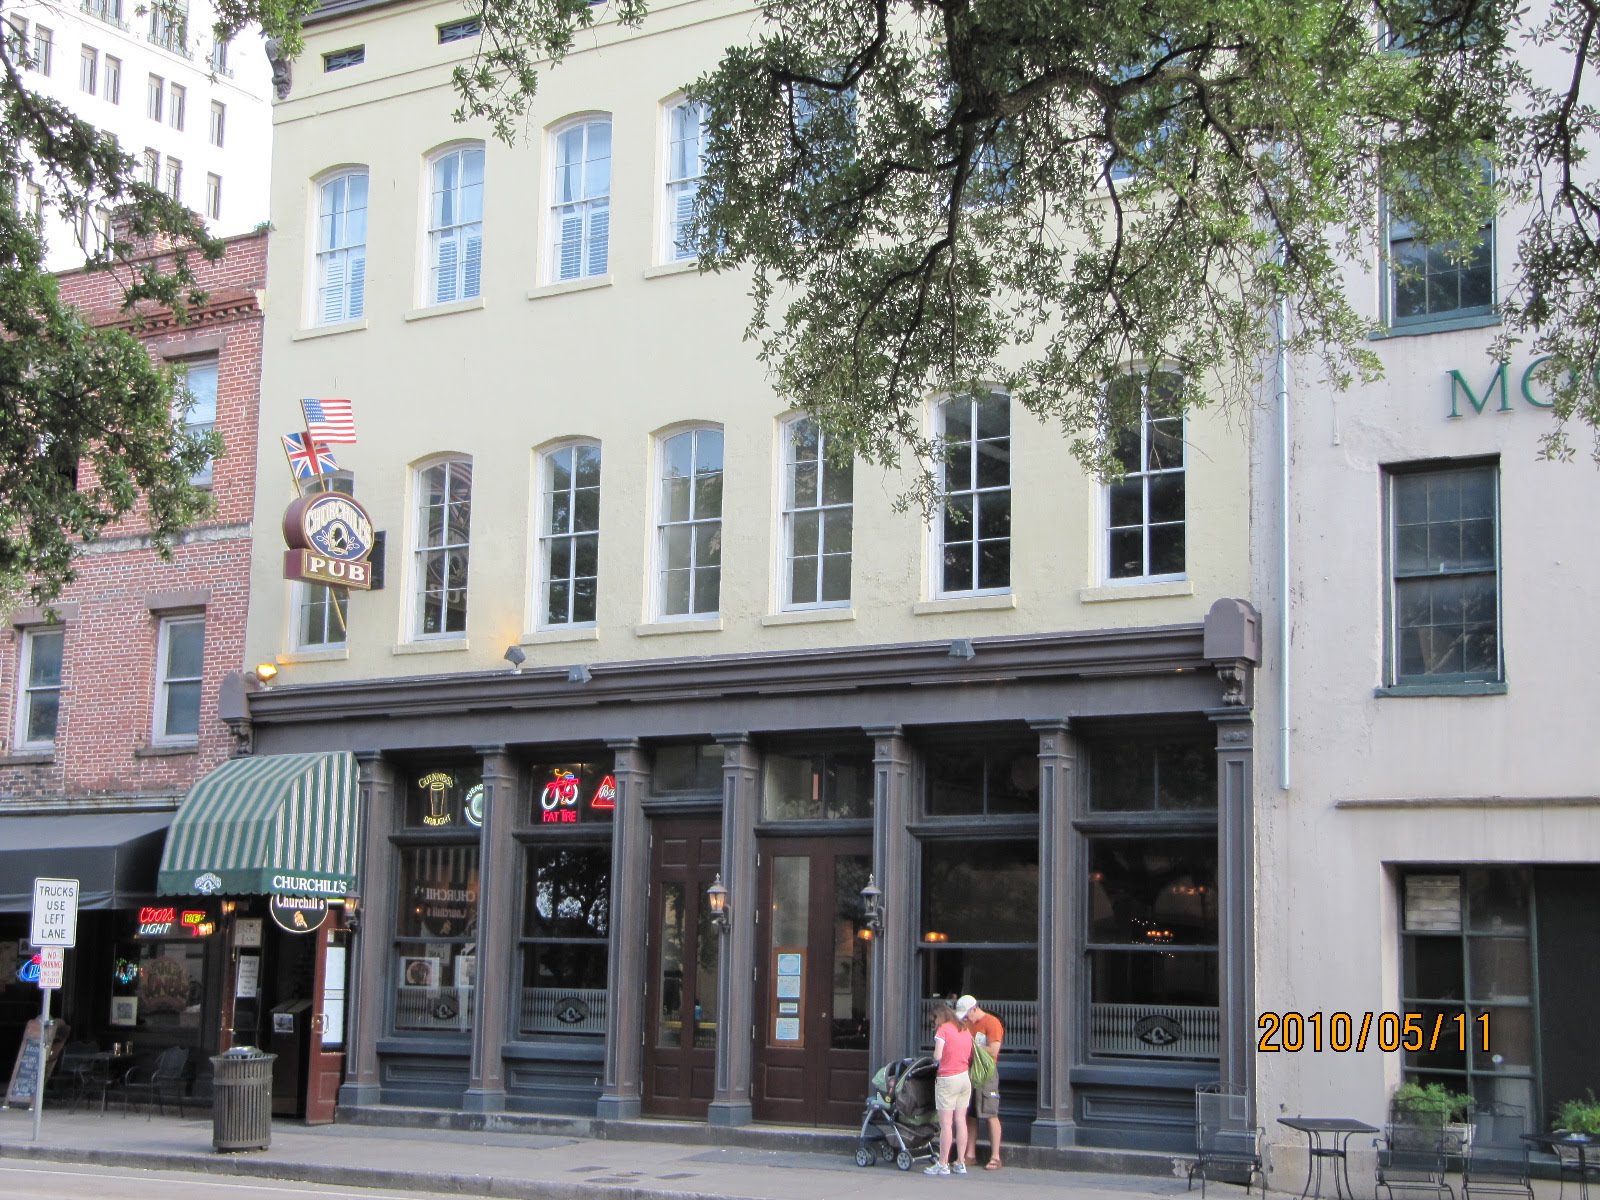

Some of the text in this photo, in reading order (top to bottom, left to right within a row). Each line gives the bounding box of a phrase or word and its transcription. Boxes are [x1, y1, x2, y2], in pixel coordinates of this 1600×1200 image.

[1445, 355, 1600, 418] MO
[310, 556, 365, 581] PUB
[418, 772, 454, 789] GUINNESS
[423, 813, 451, 826] DRAUGHT
[543, 809, 577, 823] FAT TIRE
[273, 875, 347, 894] CHURCHILL'S
[39, 886, 74, 897] TRUCKS
[46, 901, 66, 911] USE
[44, 913, 65, 925] LEFT
[140, 907, 175, 922] Coors
[41, 929, 67, 940] LANE
[140, 922, 172, 935] LIGHT
[47, 952, 57, 960] NO
